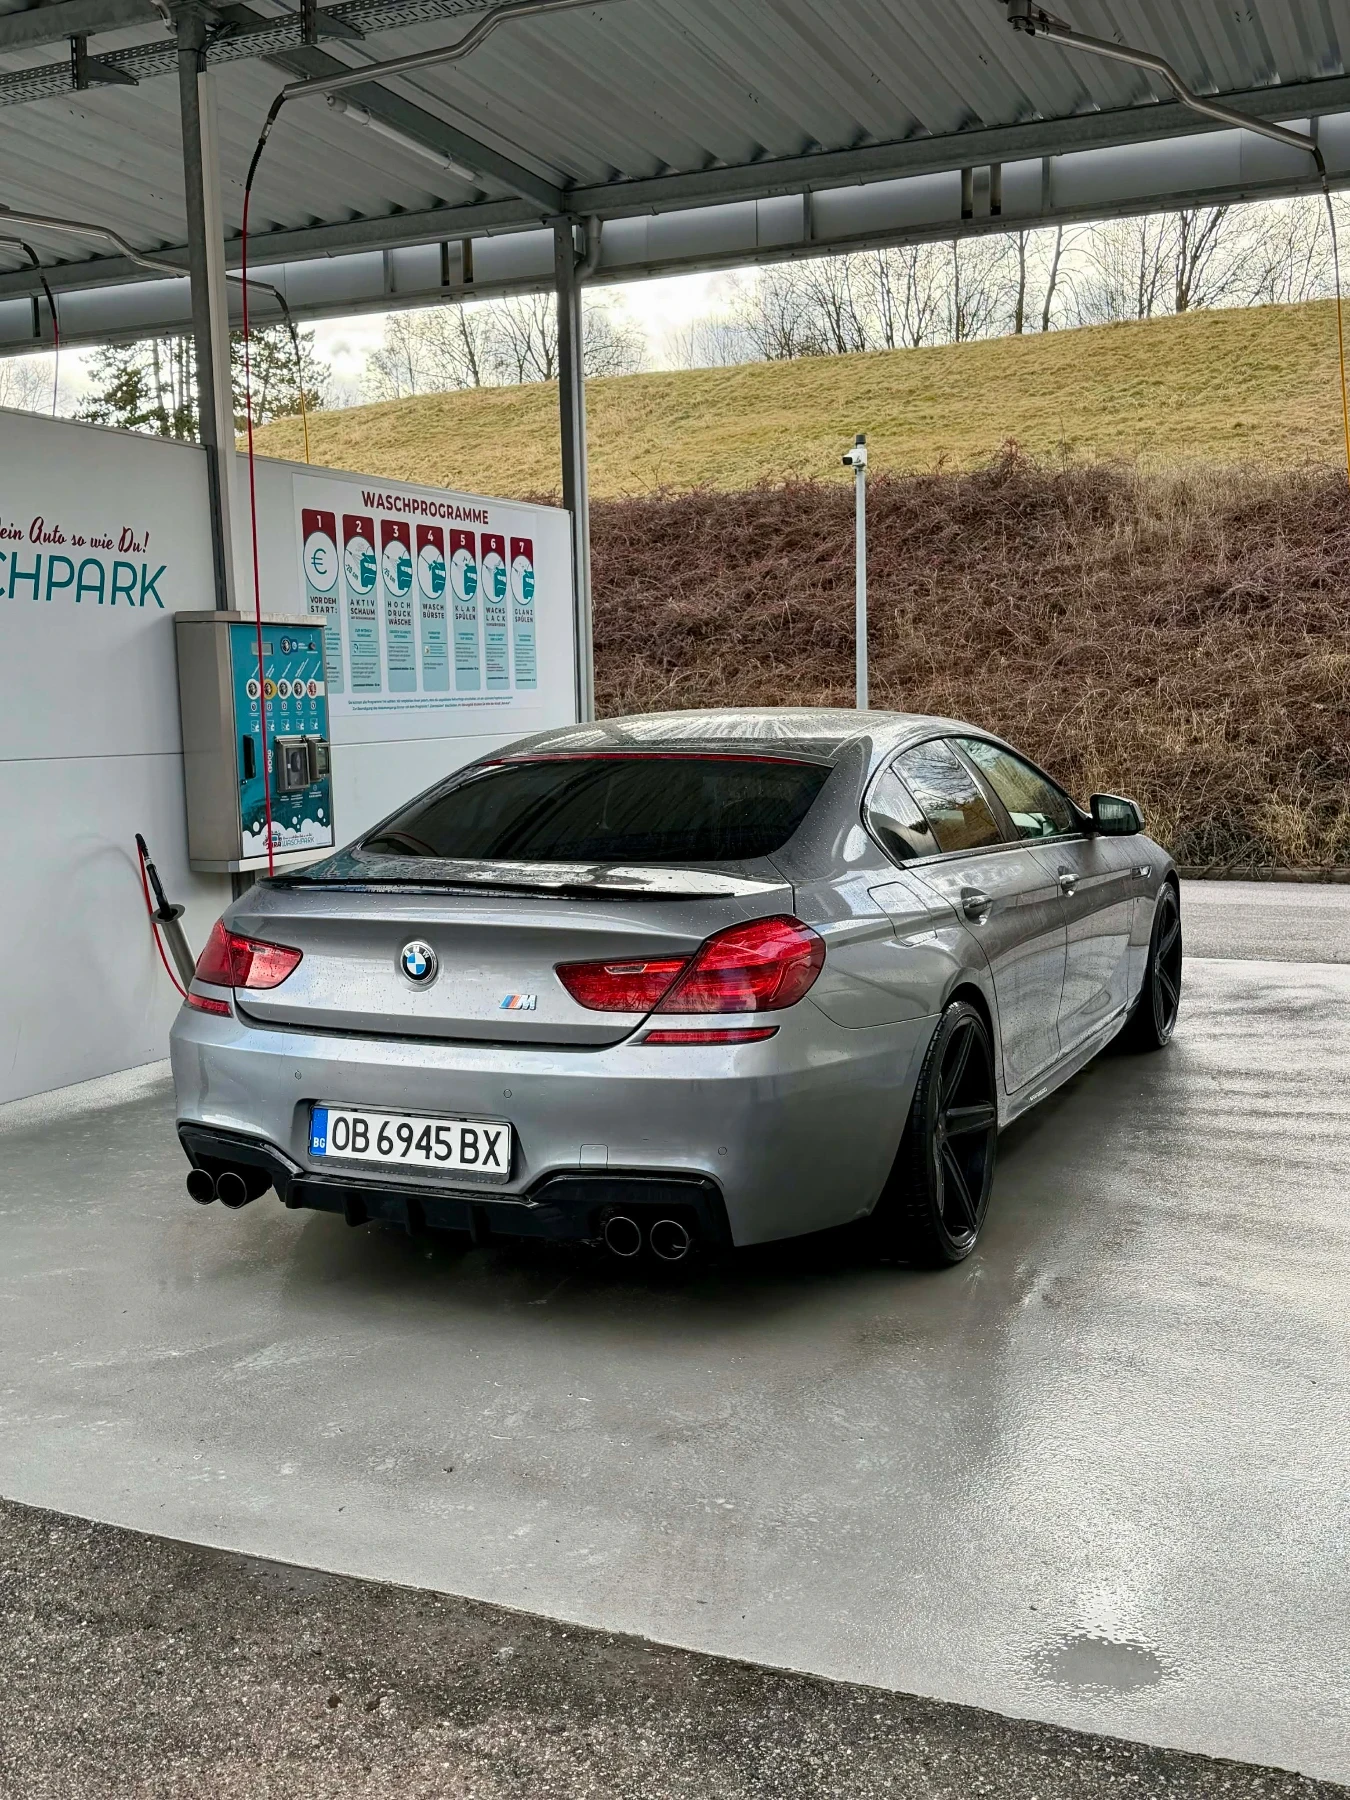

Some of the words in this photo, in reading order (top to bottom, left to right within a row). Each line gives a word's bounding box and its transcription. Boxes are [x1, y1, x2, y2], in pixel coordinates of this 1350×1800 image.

[361, 490, 489, 525] WASCHPROGRAMME
[316, 515, 322, 528] 1
[355, 520, 362, 533] 2
[393, 525, 399, 537] 3
[0, 516, 24, 540] ein
[29, 516, 67, 546] Auto
[71, 534, 86, 547] so
[90, 533, 114, 550] wie
[118, 526, 149, 553] Du!
[427, 530, 434, 542] 4
[460, 534, 466, 546] 5
[490, 538, 496, 550] 6
[519, 541, 525, 553] 7
[0, 551, 168, 609] HPARK
[310, 596, 323, 604] VOR
[323, 597, 337, 605] DEM
[350, 599, 375, 607] AKTIV
[387, 601, 411, 609] HOCH
[310, 606, 338, 614] START:
[350, 607, 376, 616] SCHAUM
[422, 603, 445, 611] WASCH
[455, 605, 476, 613] KLAR
[387, 610, 412, 618] DRUCK
[422, 610, 445, 619] BÜRSTE
[455, 612, 476, 621] SPÜLEN
[514, 608, 533, 616] GLANZ
[388, 617, 412, 626] WÄSCHE
[514, 615, 534, 623] SPÜLEN
[404, 945, 430, 959] BMW
[313, 1137, 326, 1148] BG
[332, 1116, 370, 1153] OB
[376, 1120, 453, 1162] 6945
[459, 1127, 502, 1167] BX
